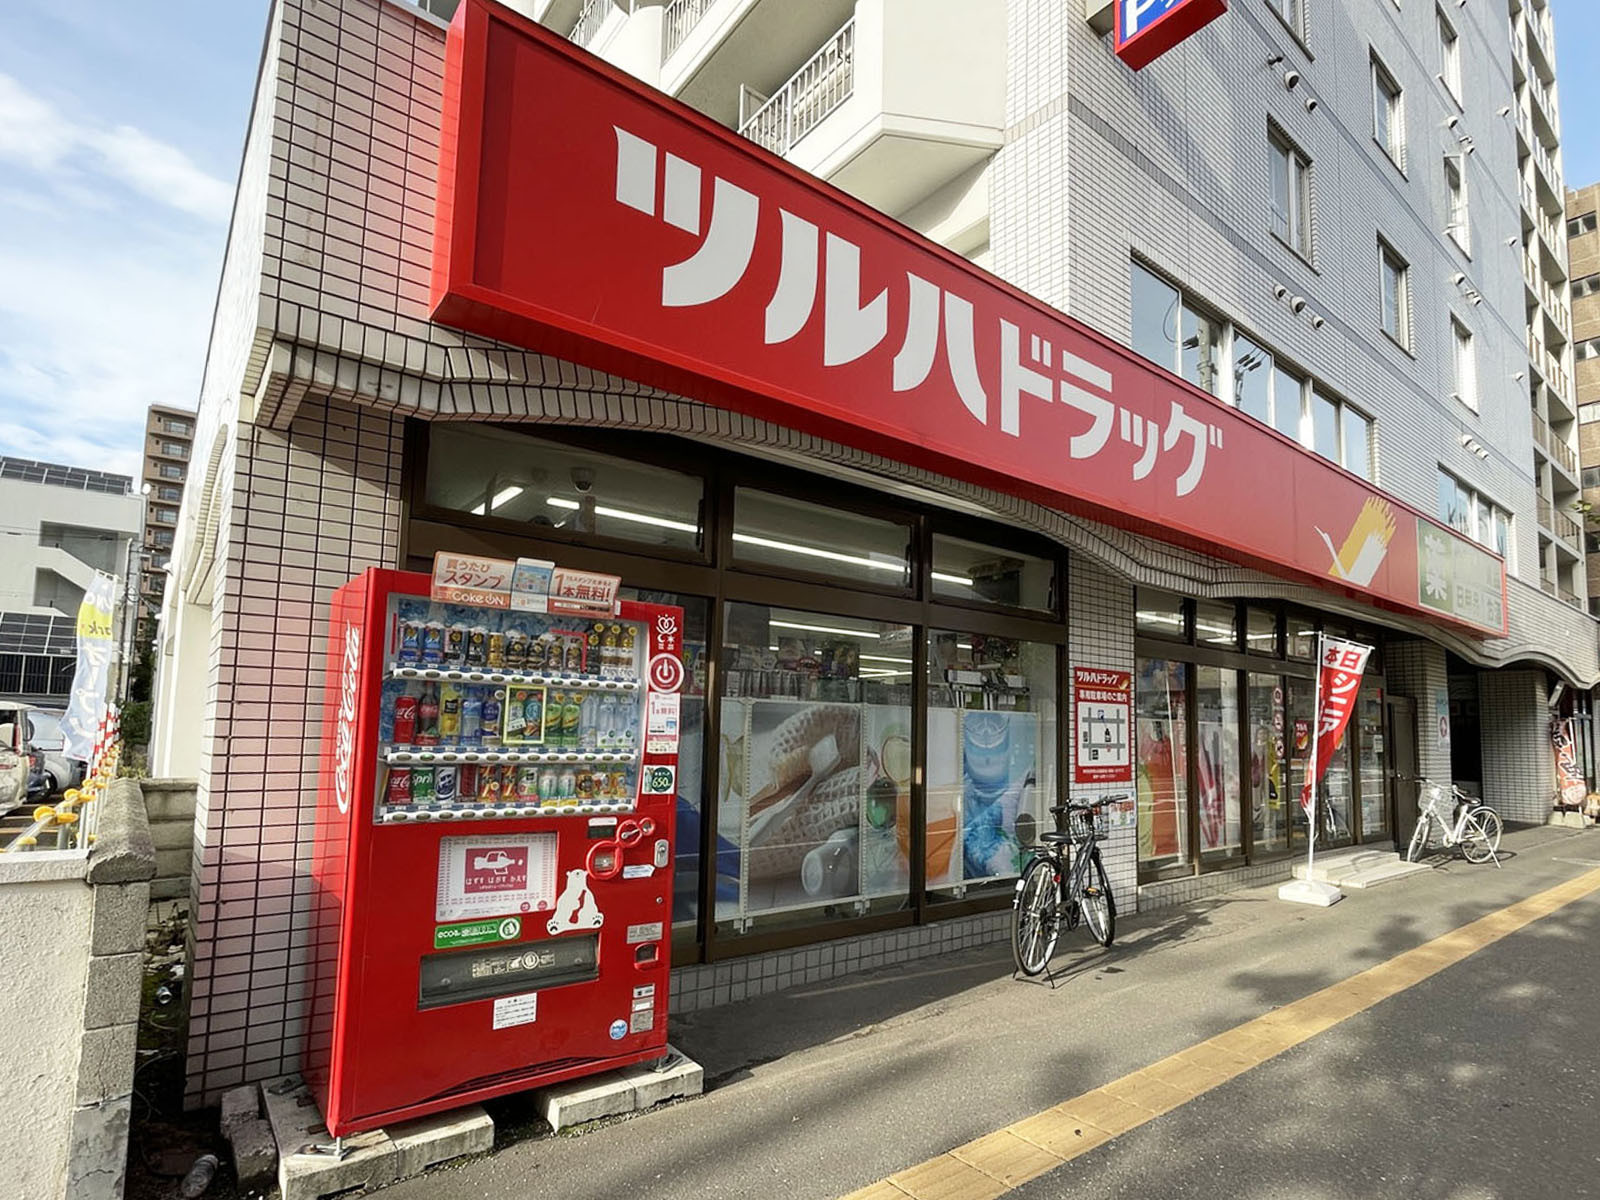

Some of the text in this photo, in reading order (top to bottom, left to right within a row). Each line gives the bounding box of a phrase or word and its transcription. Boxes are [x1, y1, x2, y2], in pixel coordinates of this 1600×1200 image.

[612, 125, 1224, 497] ツルハドラッグ
[443, 570, 505, 589] スタンプ
[452, 591, 484, 603] Coke
[1324, 646, 1361, 669] 本日
[1076, 671, 1119, 685] ツルハドラッグ
[1317, 672, 1357, 738] シニア
[335, 619, 360, 815] Coca-Cola
